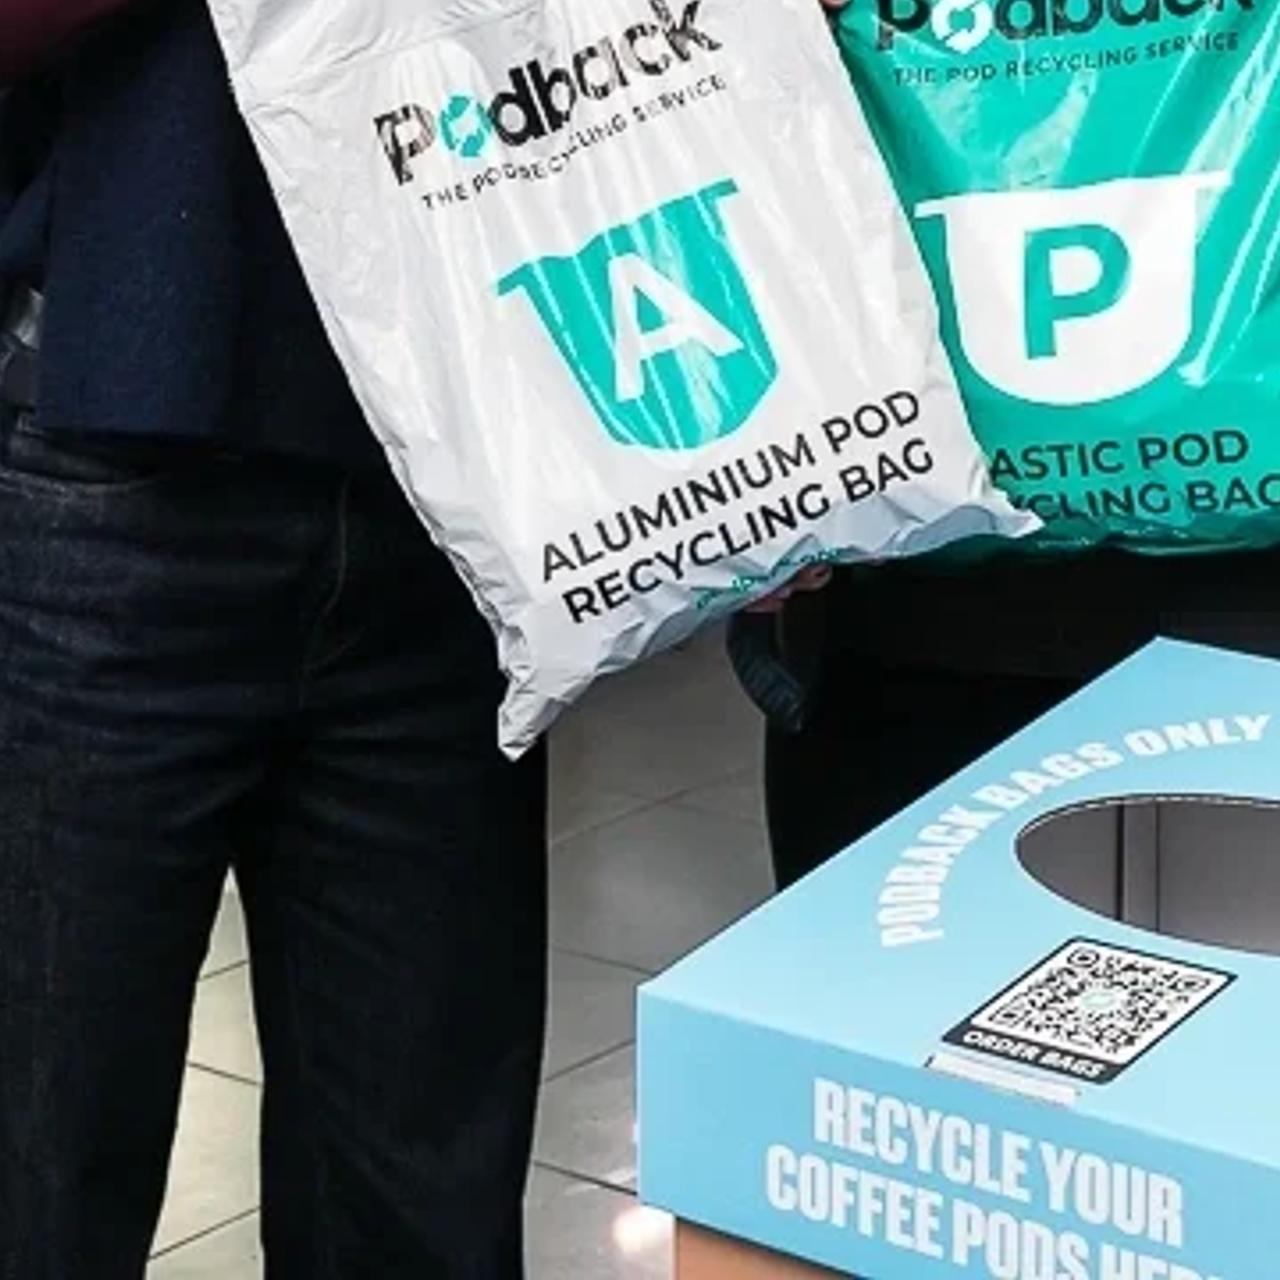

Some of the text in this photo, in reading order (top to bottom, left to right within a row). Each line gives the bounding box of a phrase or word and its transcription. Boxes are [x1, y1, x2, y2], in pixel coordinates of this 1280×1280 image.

[893, 32, 1240, 86] THE POD RECYCLING SERVICE
[423, 74, 726, 210] THE POD RECYCLING SERVICE
[608, 253, 744, 403] A
[1024, 223, 1130, 360] P
[542, 433, 816, 583] ALUMINIUM
[821, 390, 920, 455] POD
[989, 428, 1249, 481] ASTIC POD
[1013, 482, 1171, 520] CLING
[562, 484, 830, 623] RECYCLING
[839, 438, 934, 503] BAG
[877, 804, 1005, 947] PODBACK
[972, 742, 1124, 808] BAGS
[1123, 714, 1271, 756] ONLY
[963, 1031, 1106, 1077] ORDER BAGS
[766, 1144, 1090, 1280] COFFEE PODS
[813, 1077, 1183, 1248] RECYCLE YOUR
